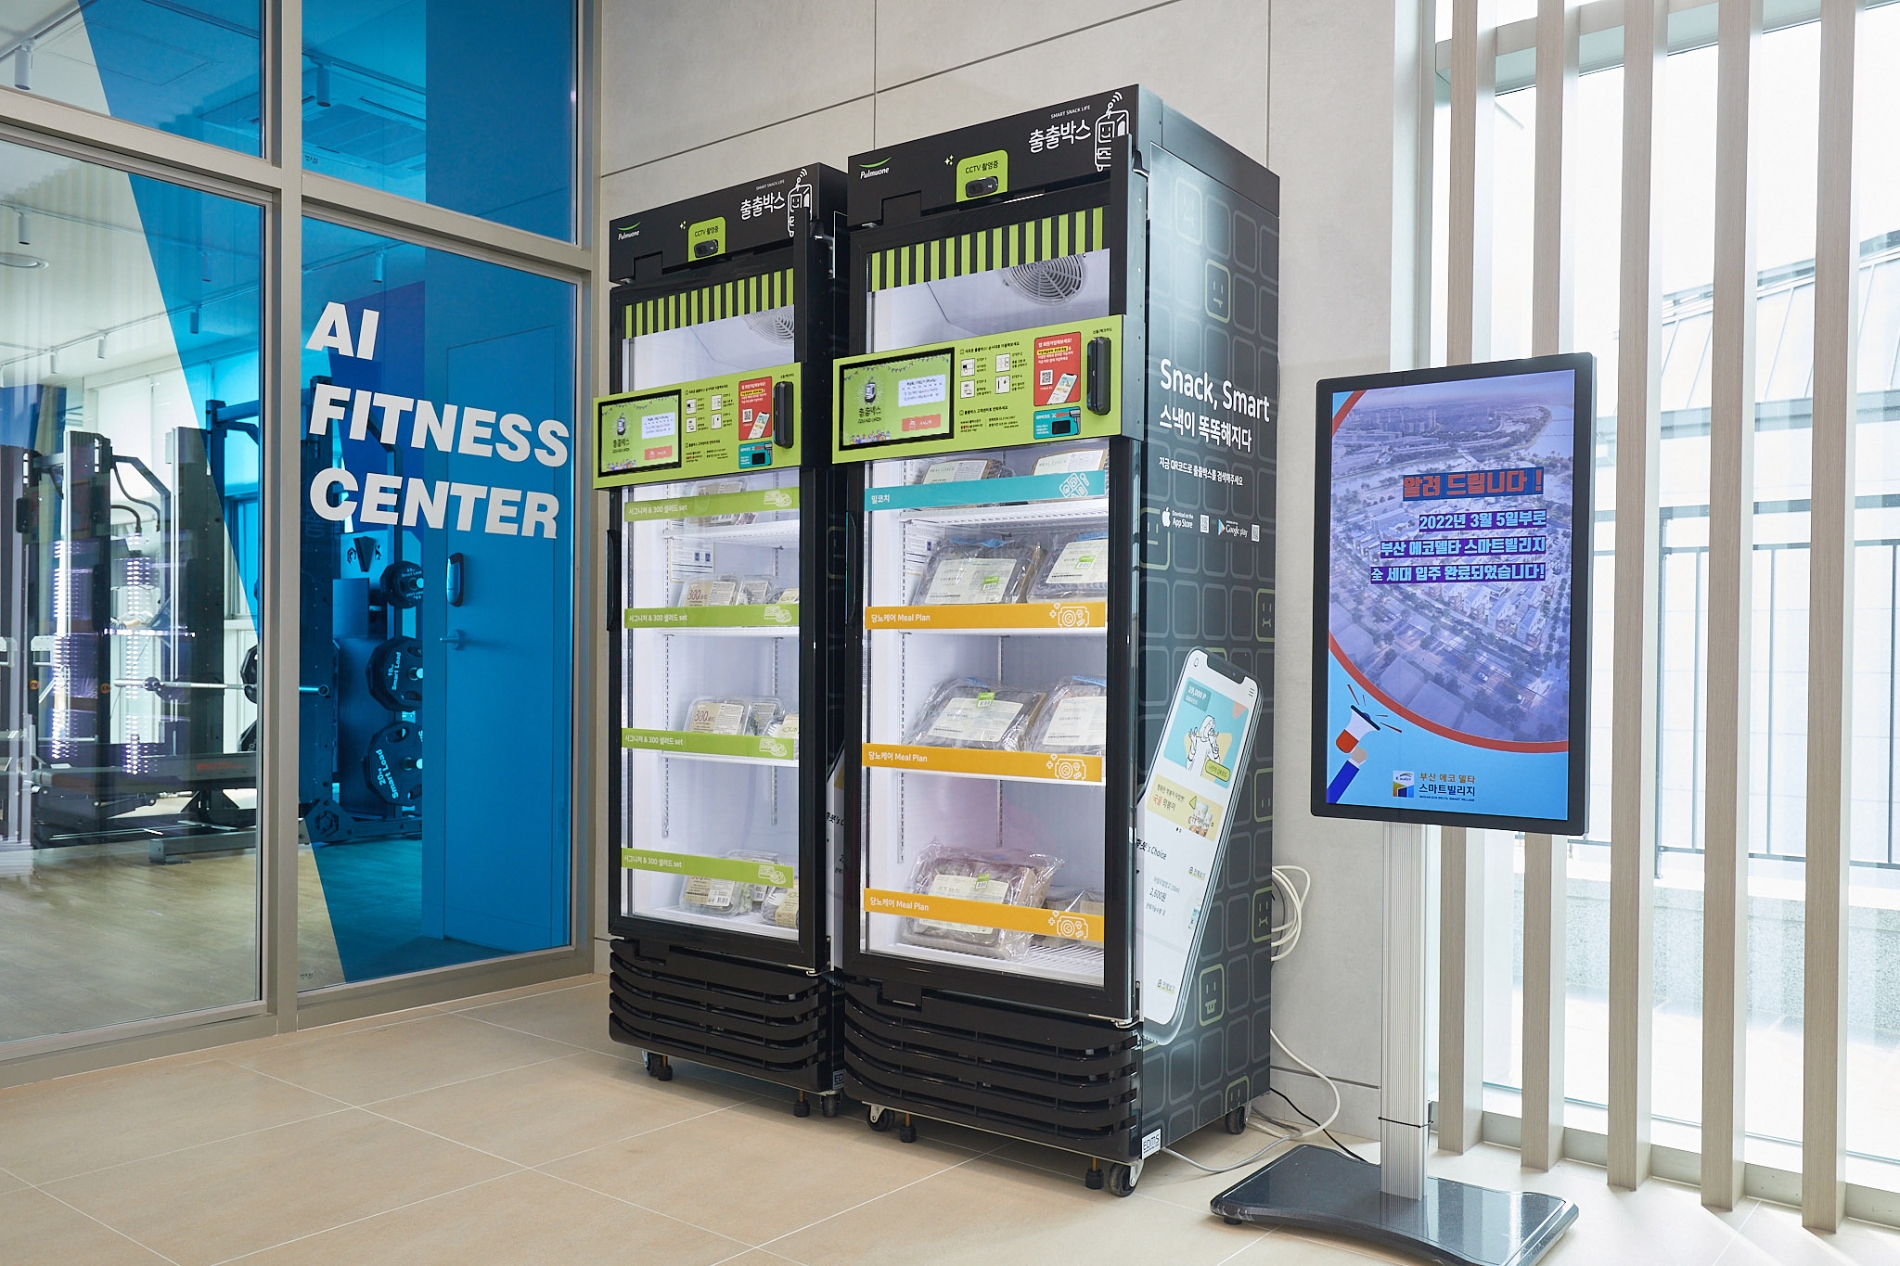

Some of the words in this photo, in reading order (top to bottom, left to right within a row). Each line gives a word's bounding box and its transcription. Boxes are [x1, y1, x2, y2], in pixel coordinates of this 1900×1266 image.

[1051, 111, 1065, 119] SMART
[1066, 107, 1081, 116] SNACK
[1081, 104, 1091, 113] LIFE
[1028, 118, 1092, 154] 출출박스
[859, 166, 890, 180] Pulmuone
[965, 163, 981, 174] CCTV
[739, 190, 786, 221] 출출박스
[617, 230, 641, 241] Pulmuone
[694, 228, 706, 238] CCTV
[305, 301, 380, 361] AI
[1160, 358, 1218, 411] Snack,
[1222, 380, 1270, 423] Smart
[309, 383, 570, 468] FITNESS
[1159, 404, 1196, 438] 스낵이
[1198, 414, 1253, 453] 똑똑해지다
[1158, 456, 1170, 470] 지금
[1170, 459, 1193, 474] QR코드로
[1403, 475, 1441, 498] 알려
[1446, 469, 1527, 496] 드립니다
[309, 467, 560, 539] CENTER
[871, 493, 890, 505] 밀코치
[1172, 517, 1182, 529] App
[1181, 518, 1193, 529] Store
[1419, 515, 1467, 530] 2022년
[1470, 512, 1492, 528] 3월
[1496, 509, 1547, 527] 5일부로
[1225, 524, 1240, 537] Google
[1239, 528, 1248, 538] play
[1381, 541, 1405, 557] 부산
[1409, 538, 1461, 556] 에코델타
[1464, 535, 1546, 555] 스마트빌리지
[1371, 568, 1384, 581] 全
[1387, 566, 1412, 582] 세대
[1415, 565, 1442, 581] 입주
[1444, 562, 1545, 581] 완료되었습니다!
[871, 613, 897, 624] 당뇨케어
[897, 613, 915, 622] Meal
[915, 613, 931, 622] Plan
[675, 738, 683, 746] set
[375, 749, 389, 771] Load
[868, 750, 894, 761] 당뇨케어
[895, 752, 911, 762] Meal
[912, 753, 928, 763] Plan
[385, 771, 399, 799] Smart
[1420, 772, 1437, 782] 부산
[1440, 773, 1456, 783] 에코
[1458, 774, 1475, 784] 델타
[1419, 783, 1476, 797] 스마트빌리지
[1151, 845, 1167, 860] Choice
[869, 896, 895, 908] 당뇨케어
[896, 900, 913, 909] Meal
[913, 901, 930, 911] Plan
